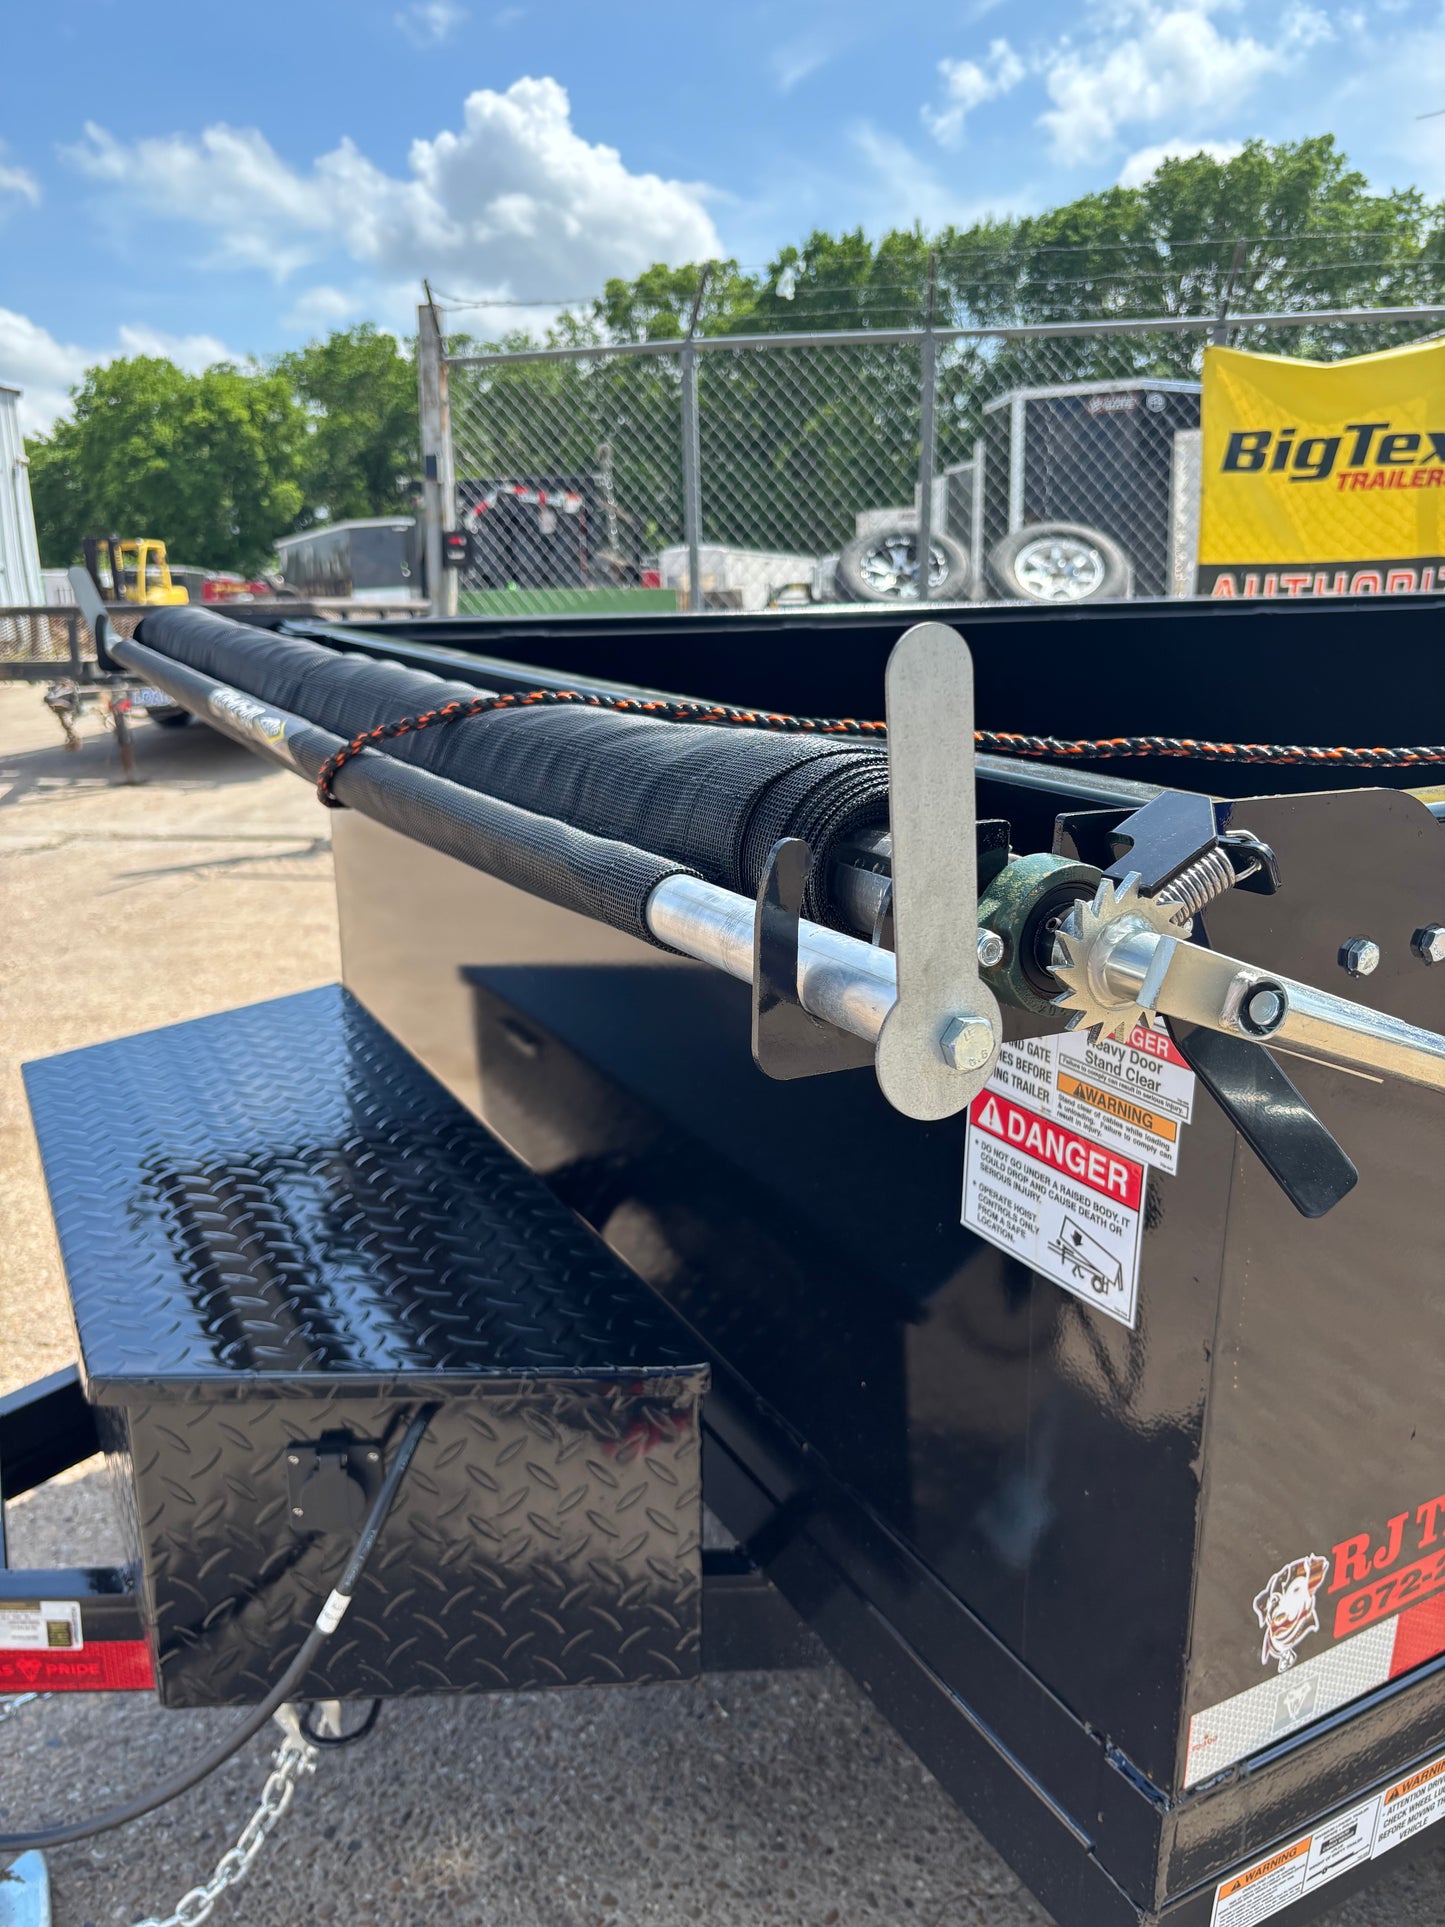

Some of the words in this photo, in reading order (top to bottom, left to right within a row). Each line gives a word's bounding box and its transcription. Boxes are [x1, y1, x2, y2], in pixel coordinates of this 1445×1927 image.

[1337, 467, 1445, 492] TRAILER
[1026, 1041, 1052, 1064] GATE
[1087, 1040, 1126, 1062] eavy
[1130, 1049, 1164, 1075] Door
[1127, 1028, 1169, 1059] GER
[992, 1066, 1009, 1085] ING
[1011, 1073, 1050, 1104] TRAILER
[1015, 1056, 1052, 1085] BEFORE
[1085, 1049, 1122, 1077] Stand
[1125, 1066, 1162, 1093] Clear
[1058, 1093, 1076, 1107] Stand
[1076, 1103, 1092, 1115] clear
[1093, 1110, 1101, 1119] of
[1102, 1115, 1124, 1130] cables
[1125, 1125, 1143, 1139] while
[1144, 1132, 1170, 1152] loading
[1075, 1118, 1082, 1127] in
[1085, 1086, 1153, 1130] WARNING
[1007, 1109, 1129, 1198] DANGER
[1100, 1120, 1122, 1138] Failure
[1123, 1131, 1131, 1141] to
[1132, 1137, 1157, 1155] comply
[1159, 1150, 1173, 1161] can
[980, 1161, 1012, 1187] SERIOUS
[981, 1141, 992, 1154] DO
[993, 1147, 1009, 1162] NOT
[1009, 1156, 1022, 1170] GO
[1023, 1163, 1051, 1186] UNDER
[1051, 1180, 1058, 1191] A
[1059, 1184, 1091, 1208] RAISED
[1121, 1216, 1131, 1228] IT
[978, 1182, 1013, 1209] OPERATE
[1013, 1202, 1037, 1222] HOIST
[980, 1151, 1006, 1172] COULD
[1006, 1166, 1029, 1183] DROP
[1029, 1179, 1047, 1195] AND
[1048, 1189, 1077, 1212] CAUSE
[1078, 1204, 1107, 1229] DEATH
[1108, 1222, 1123, 1237] OR
[977, 1192, 1018, 1222] CONTROLS
[1019, 1217, 1040, 1236] ONLY
[977, 1202, 999, 1221] FROM
[999, 1216, 1006, 1226] A
[1006, 1220, 1027, 1239] SAFE
[1327, 1511, 1409, 1595] RJ
[1416, 1494, 1445, 1549] T
[45, 1663, 100, 1677] PRIDE
[1383, 1808, 1408, 1829] CHECK
[1408, 1793, 1432, 1814] WHEEL
[1387, 1785, 1427, 1817] ATTENTION
[1378, 1819, 1407, 1843] BEFORE
[1407, 1802, 1436, 1826] MOVING
[1400, 1816, 1429, 1840] VEHICLE
[1245, 1847, 1298, 1882] WARNING
